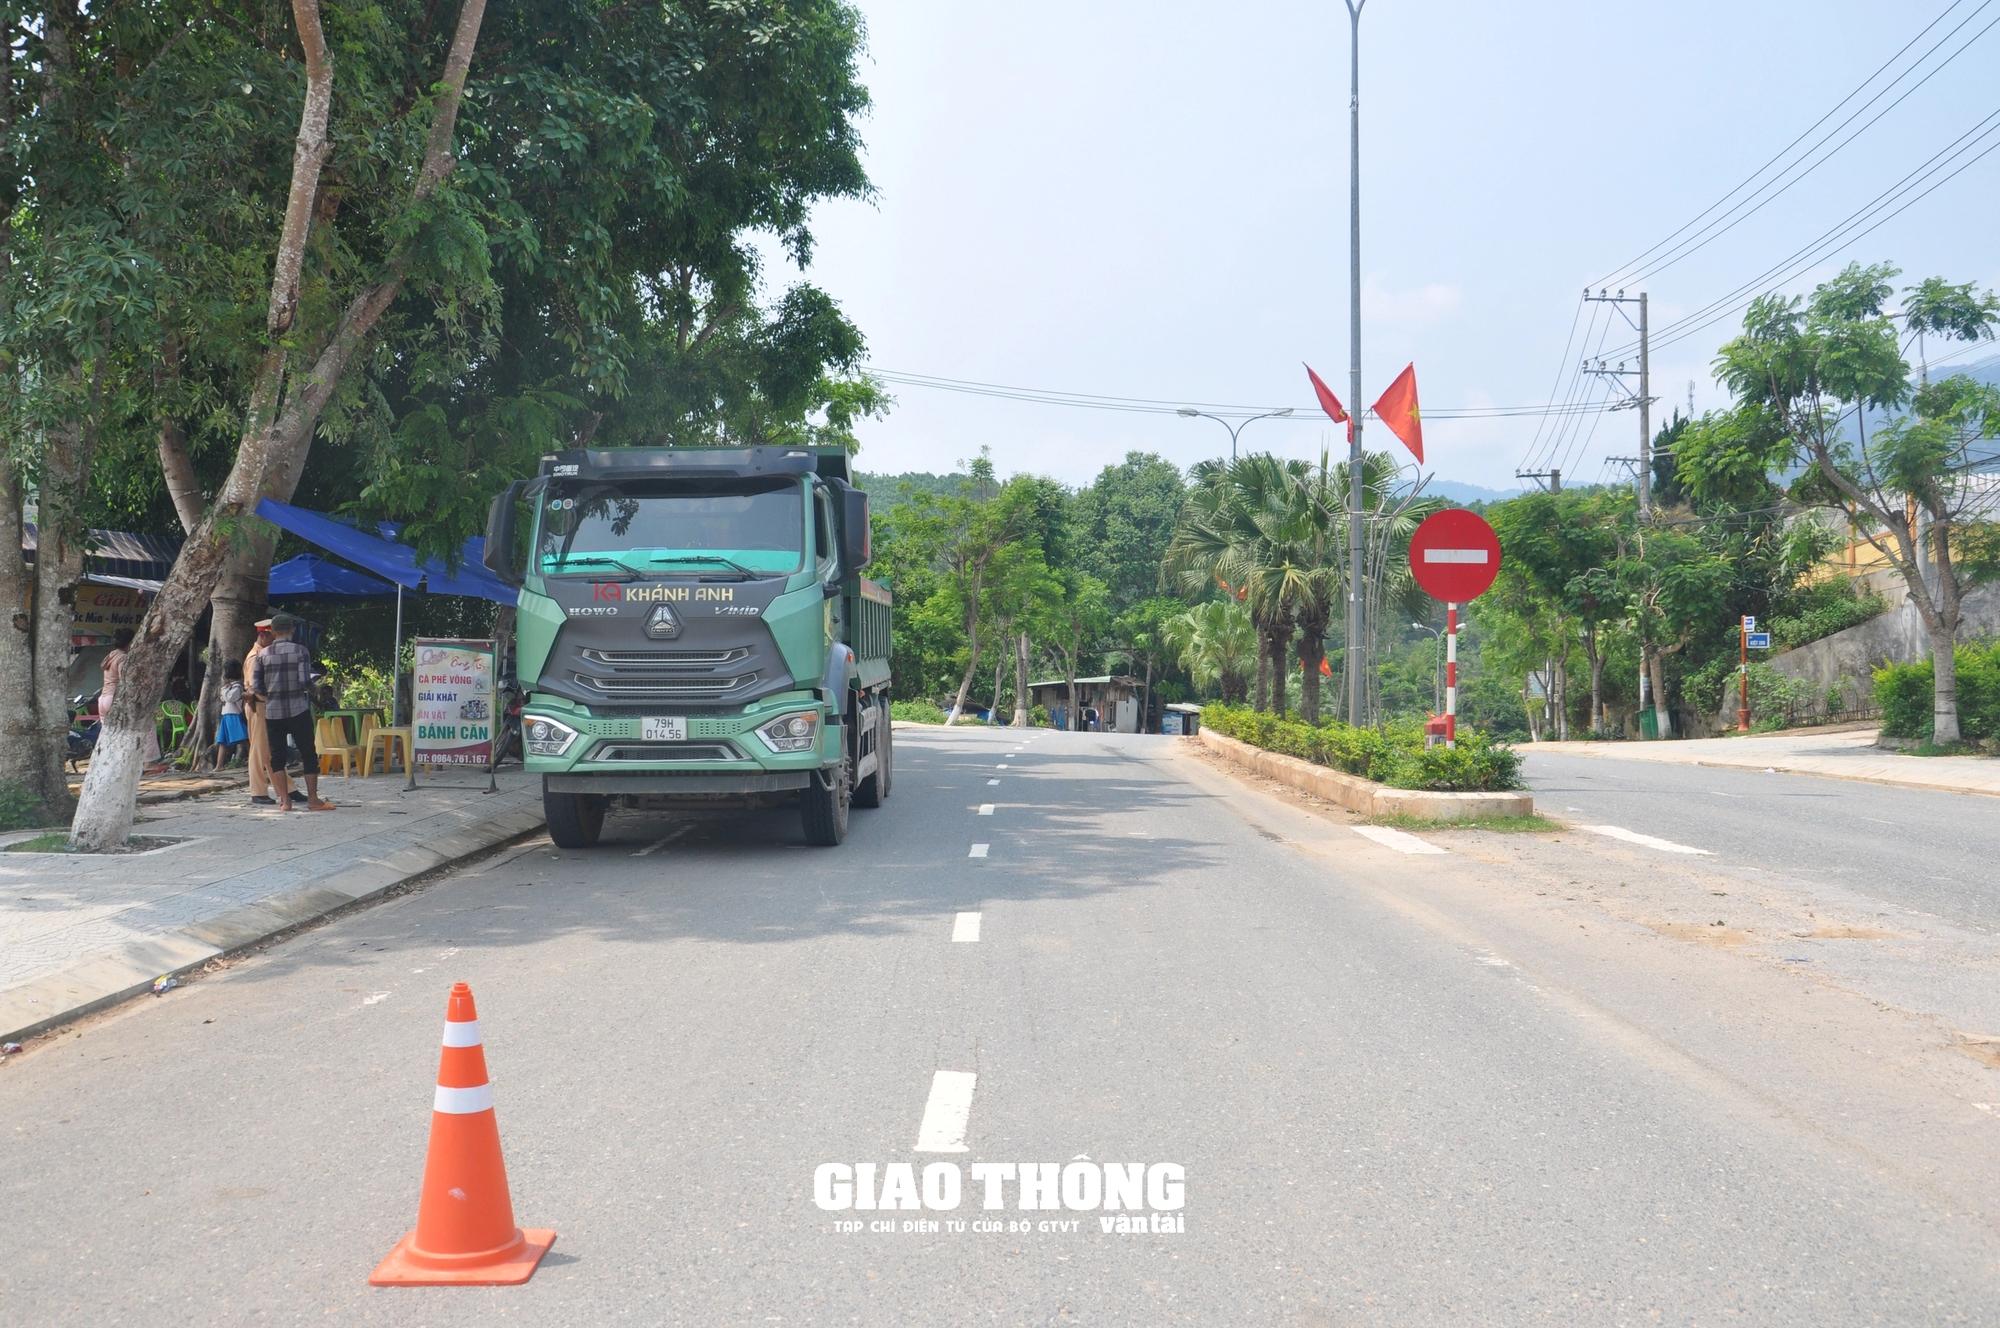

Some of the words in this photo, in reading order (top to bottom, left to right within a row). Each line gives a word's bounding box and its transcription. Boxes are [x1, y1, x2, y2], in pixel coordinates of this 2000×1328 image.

[626, 584, 689, 601] KHÁNH
[695, 588, 733, 601] ANH
[569, 607, 618, 616] HOWO
[418, 674, 429, 684] CÀ
[432, 674, 447, 684] PHÊ
[449, 674, 472, 684] VÕNG
[418, 690, 434, 701] GIẢI
[436, 691, 457, 701] KHÁT
[431, 709, 447, 721] VẬT
[654, 718, 674, 728] 79H
[418, 723, 455, 739] BÁNH
[460, 724, 488, 740] CĂN
[646, 729, 681, 739] 014.56
[417, 754, 429, 762] ĐT:
[431, 754, 487, 763] 0964.761.167
